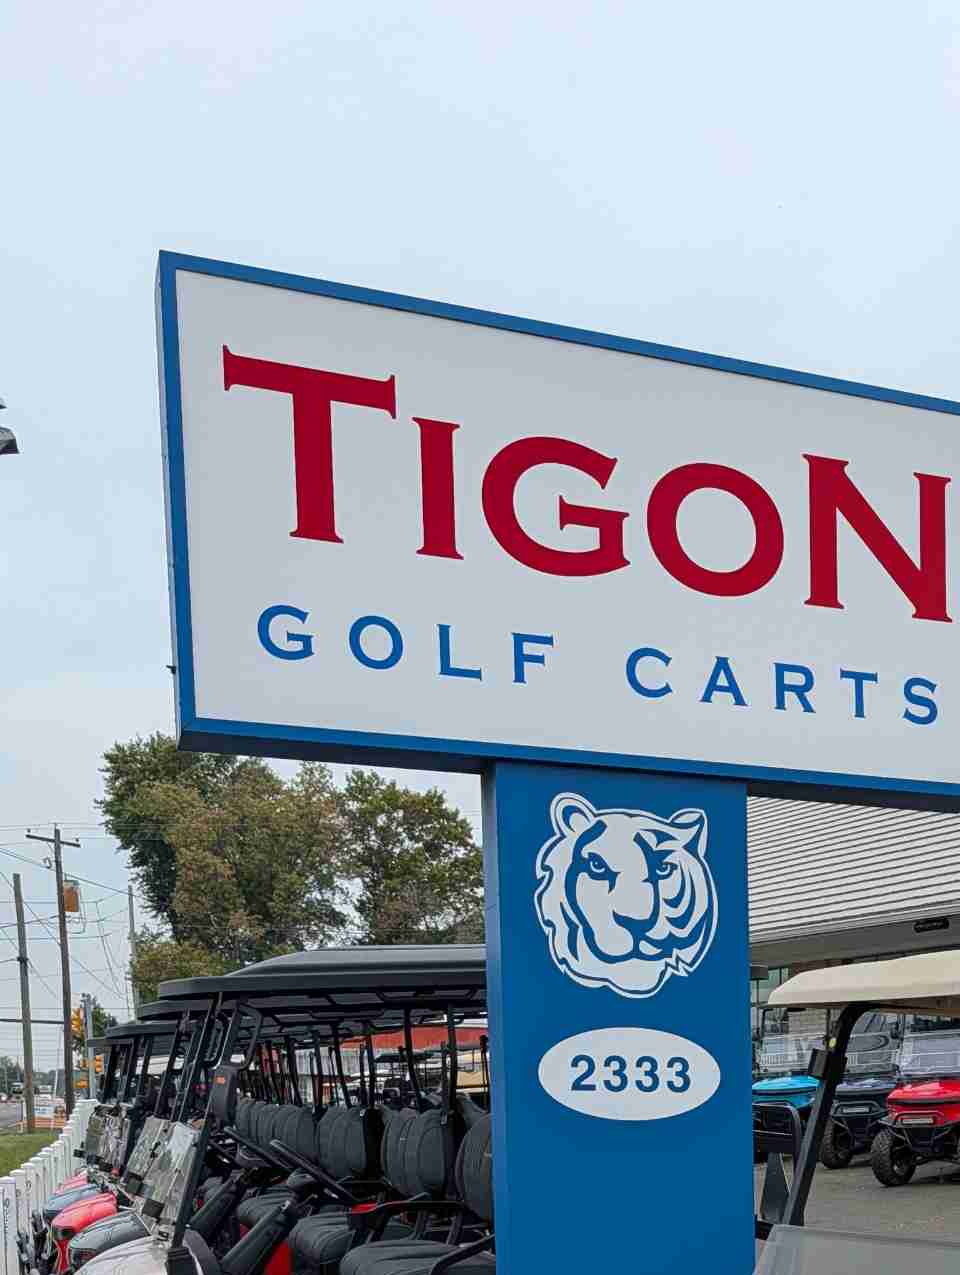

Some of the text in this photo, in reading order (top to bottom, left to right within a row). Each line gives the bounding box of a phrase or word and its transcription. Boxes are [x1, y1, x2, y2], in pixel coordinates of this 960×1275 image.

[222, 345, 952, 623] TIGON
[257, 604, 939, 726] GOLF CARTS
[570, 1054, 691, 1093] 2333
